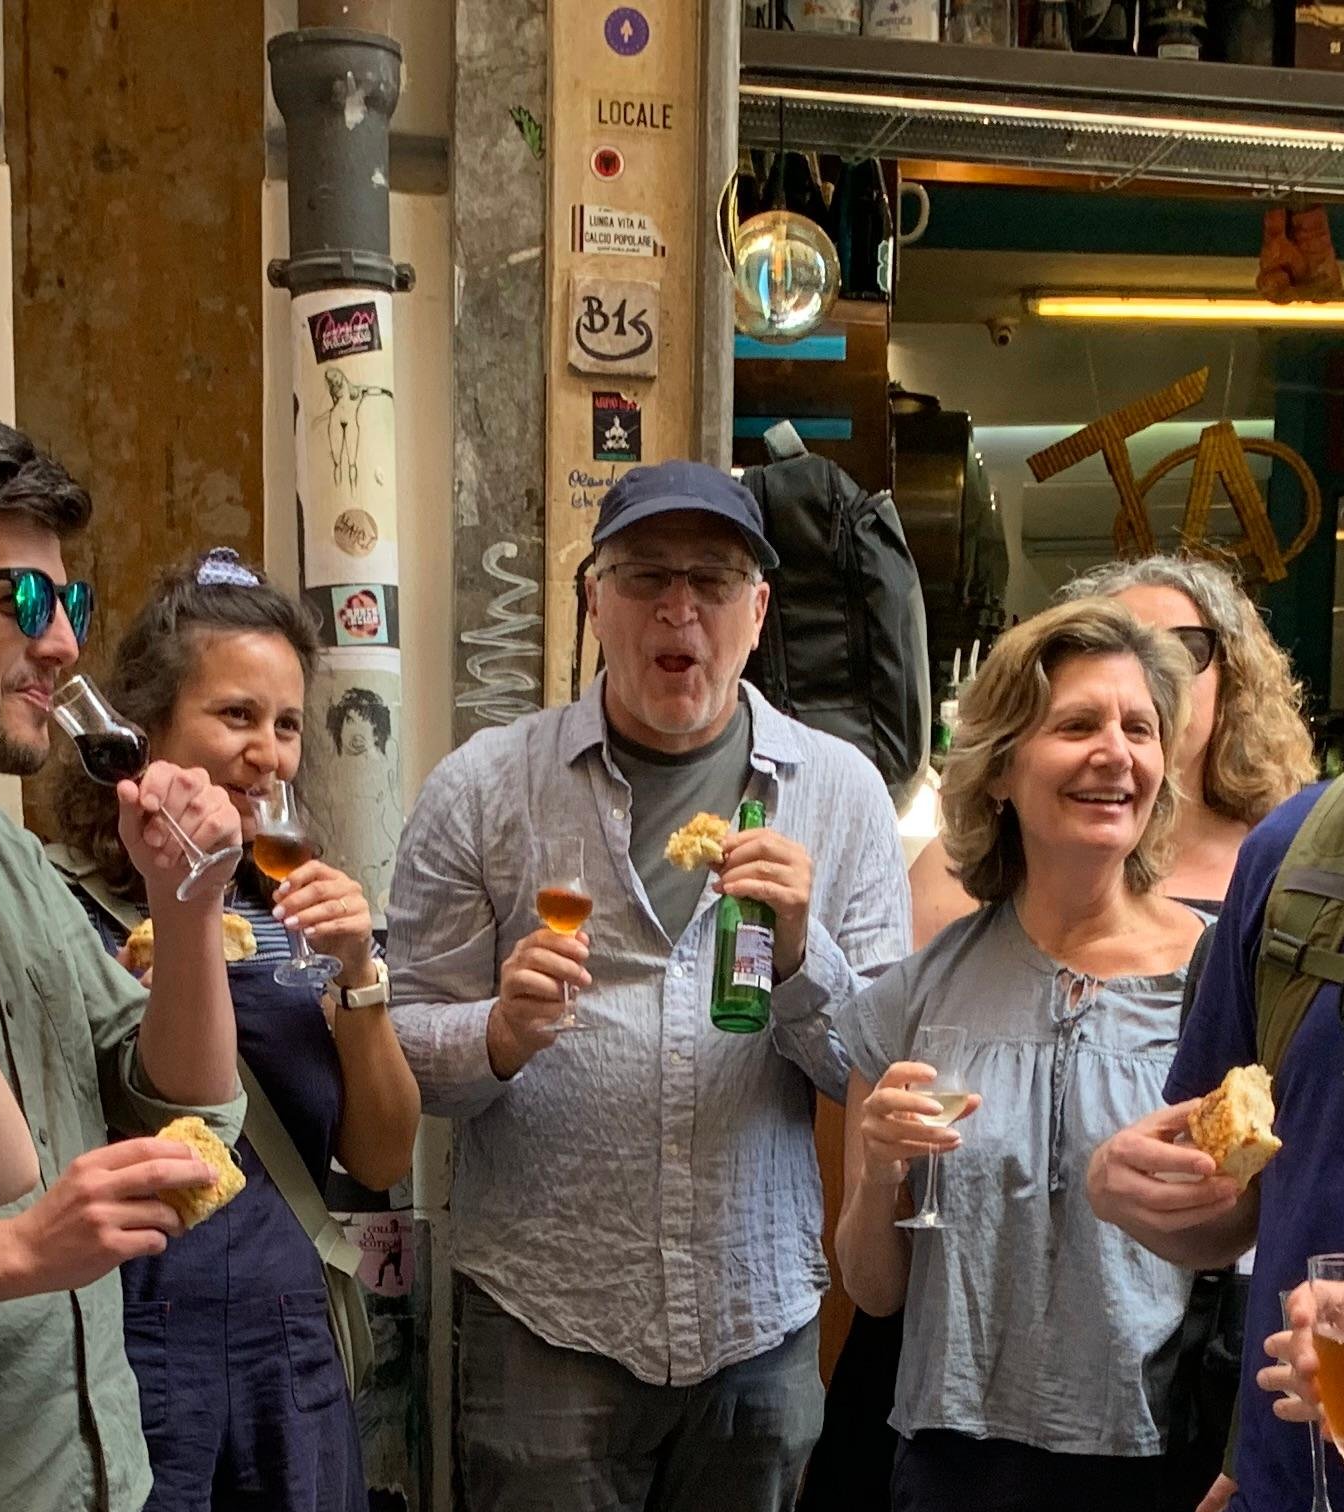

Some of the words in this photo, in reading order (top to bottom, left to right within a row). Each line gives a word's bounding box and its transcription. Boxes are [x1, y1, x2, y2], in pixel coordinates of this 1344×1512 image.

[598, 98, 673, 130] LOCALE
[589, 215, 614, 228] LUNGA
[617, 216, 634, 229] VITA
[637, 218, 647, 230] AL
[584, 231, 612, 244] CALCIO
[613, 234, 652, 248] POPOLARE
